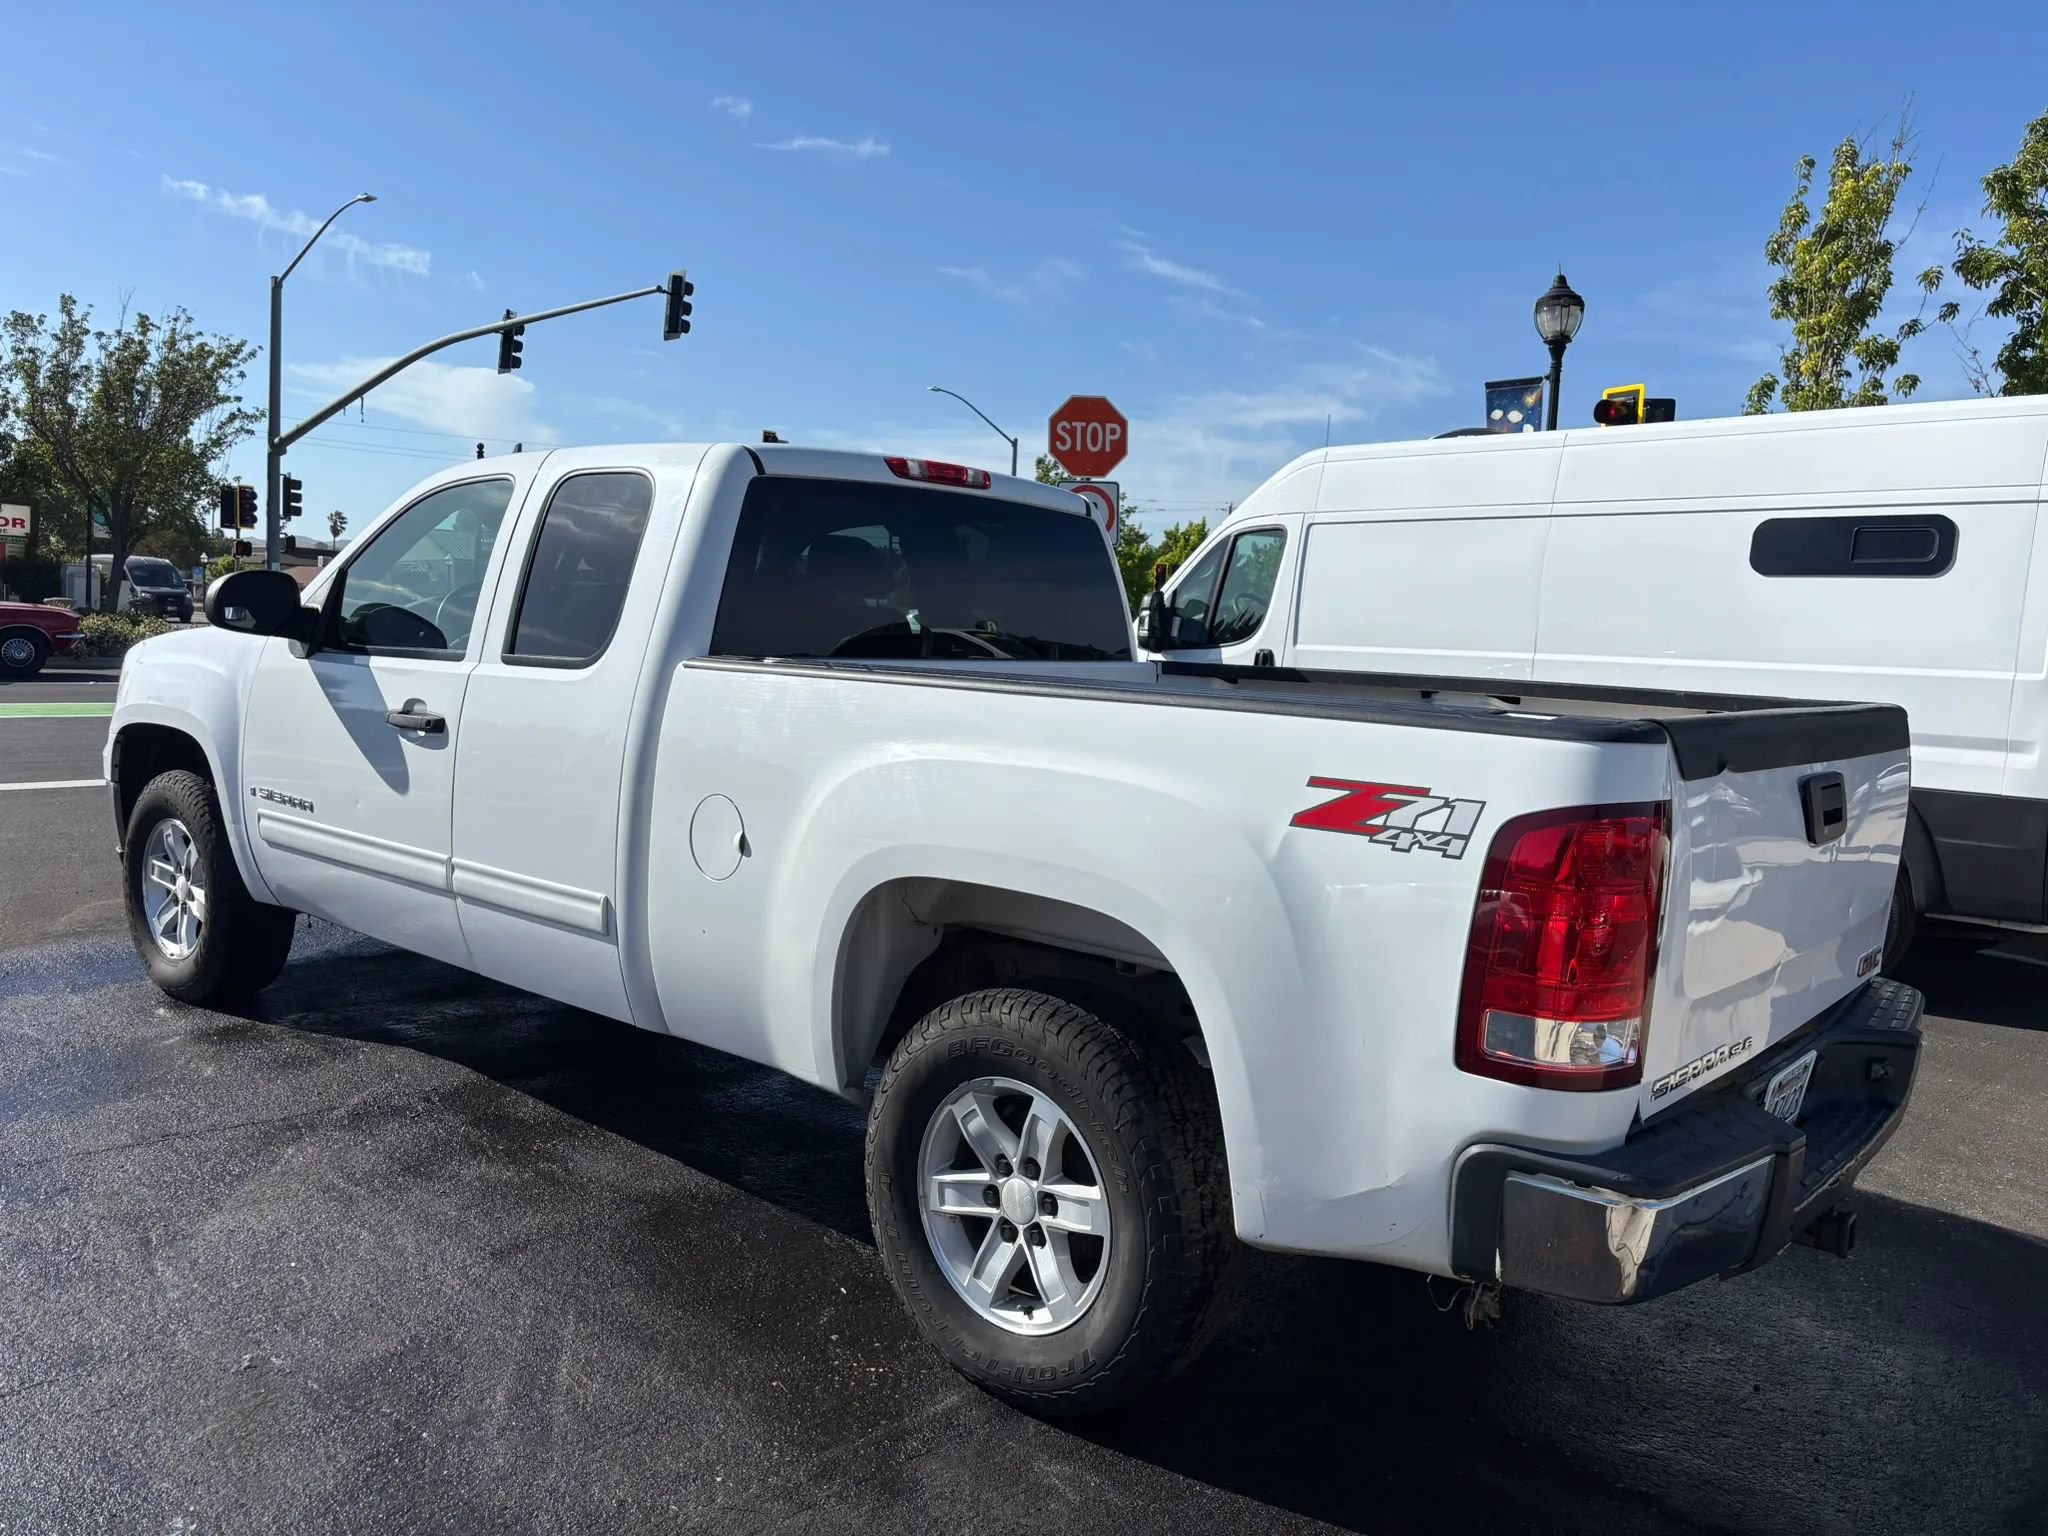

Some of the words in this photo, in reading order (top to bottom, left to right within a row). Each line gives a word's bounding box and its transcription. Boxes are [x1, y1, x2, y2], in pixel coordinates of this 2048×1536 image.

[1055, 420, 1122, 453] STOP
[258, 787, 315, 814] SIERRA
[1288, 775, 1487, 837] Z71
[1650, 1043, 1729, 1101] SIERRA
